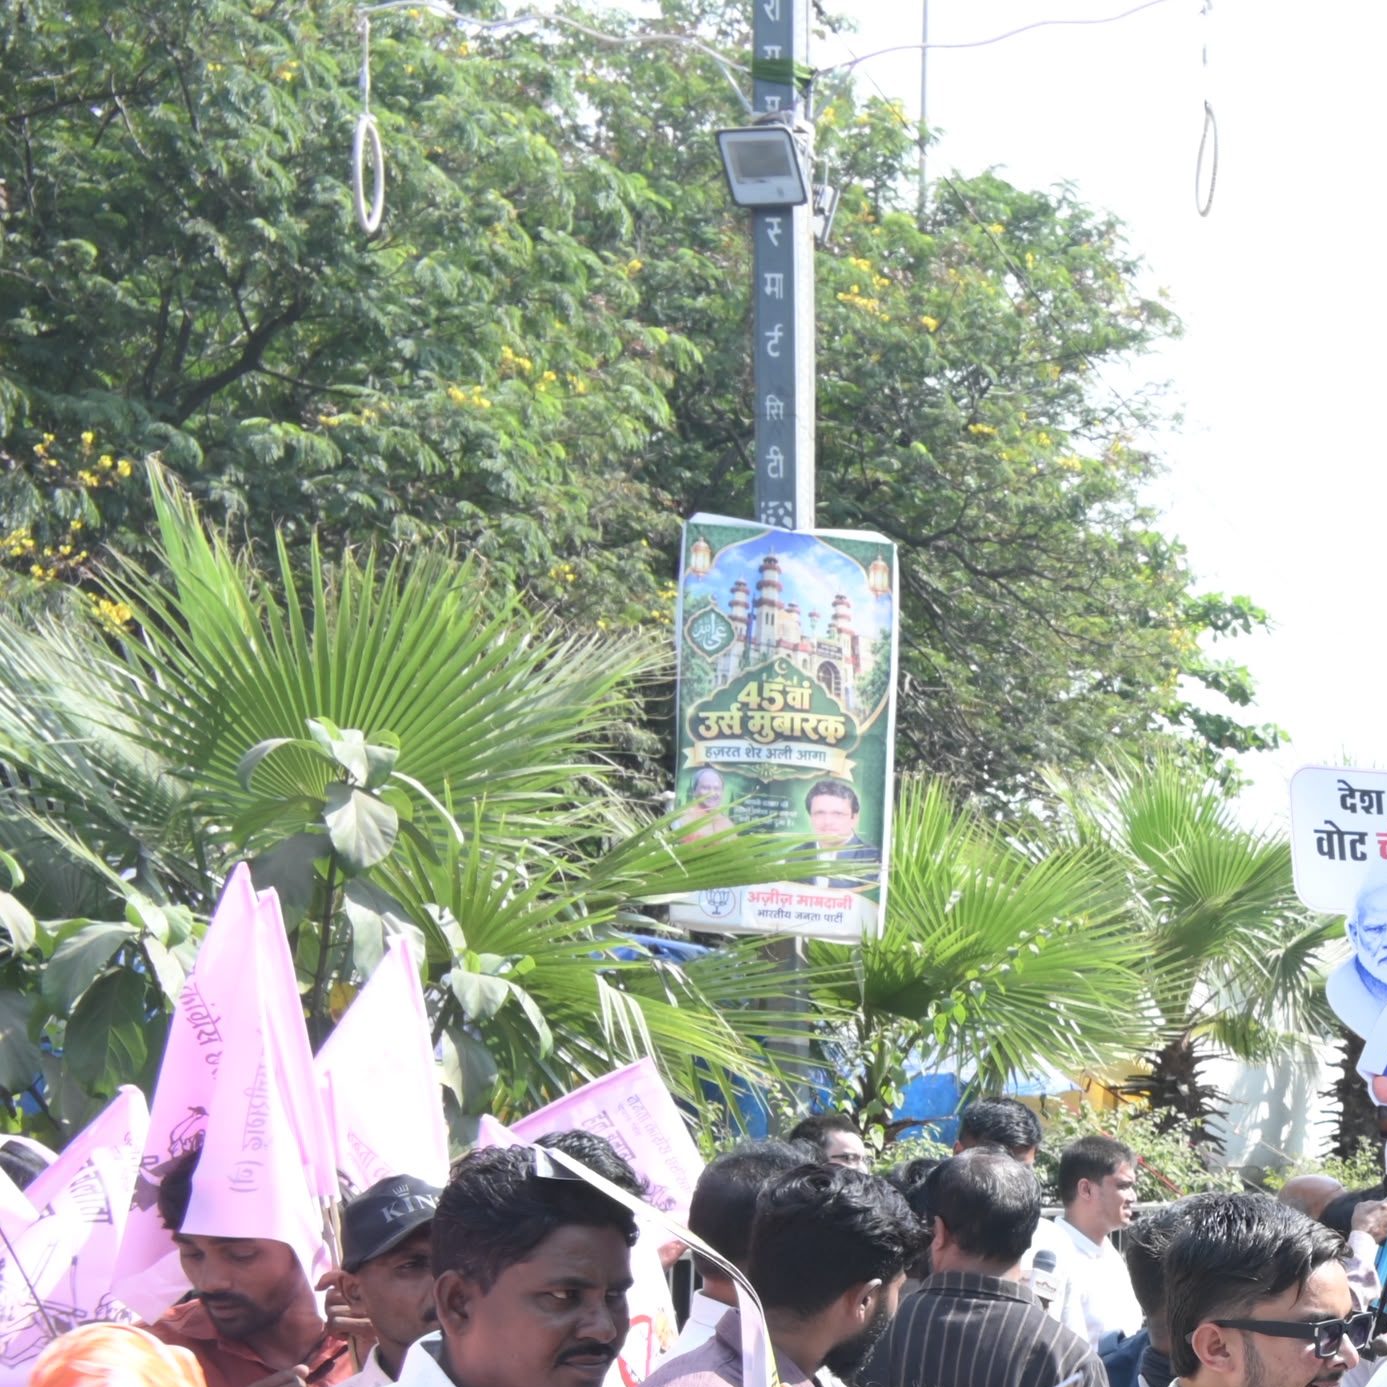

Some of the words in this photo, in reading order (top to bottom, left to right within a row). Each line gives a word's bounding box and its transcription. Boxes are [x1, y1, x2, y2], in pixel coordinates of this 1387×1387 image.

[698, 703, 743, 738] उर्स
[766, 744, 793, 761] अली
[1337, 779, 1385, 815] देश
[1313, 820, 1368, 861] वोट
[381, 1193, 439, 1224] KIN
